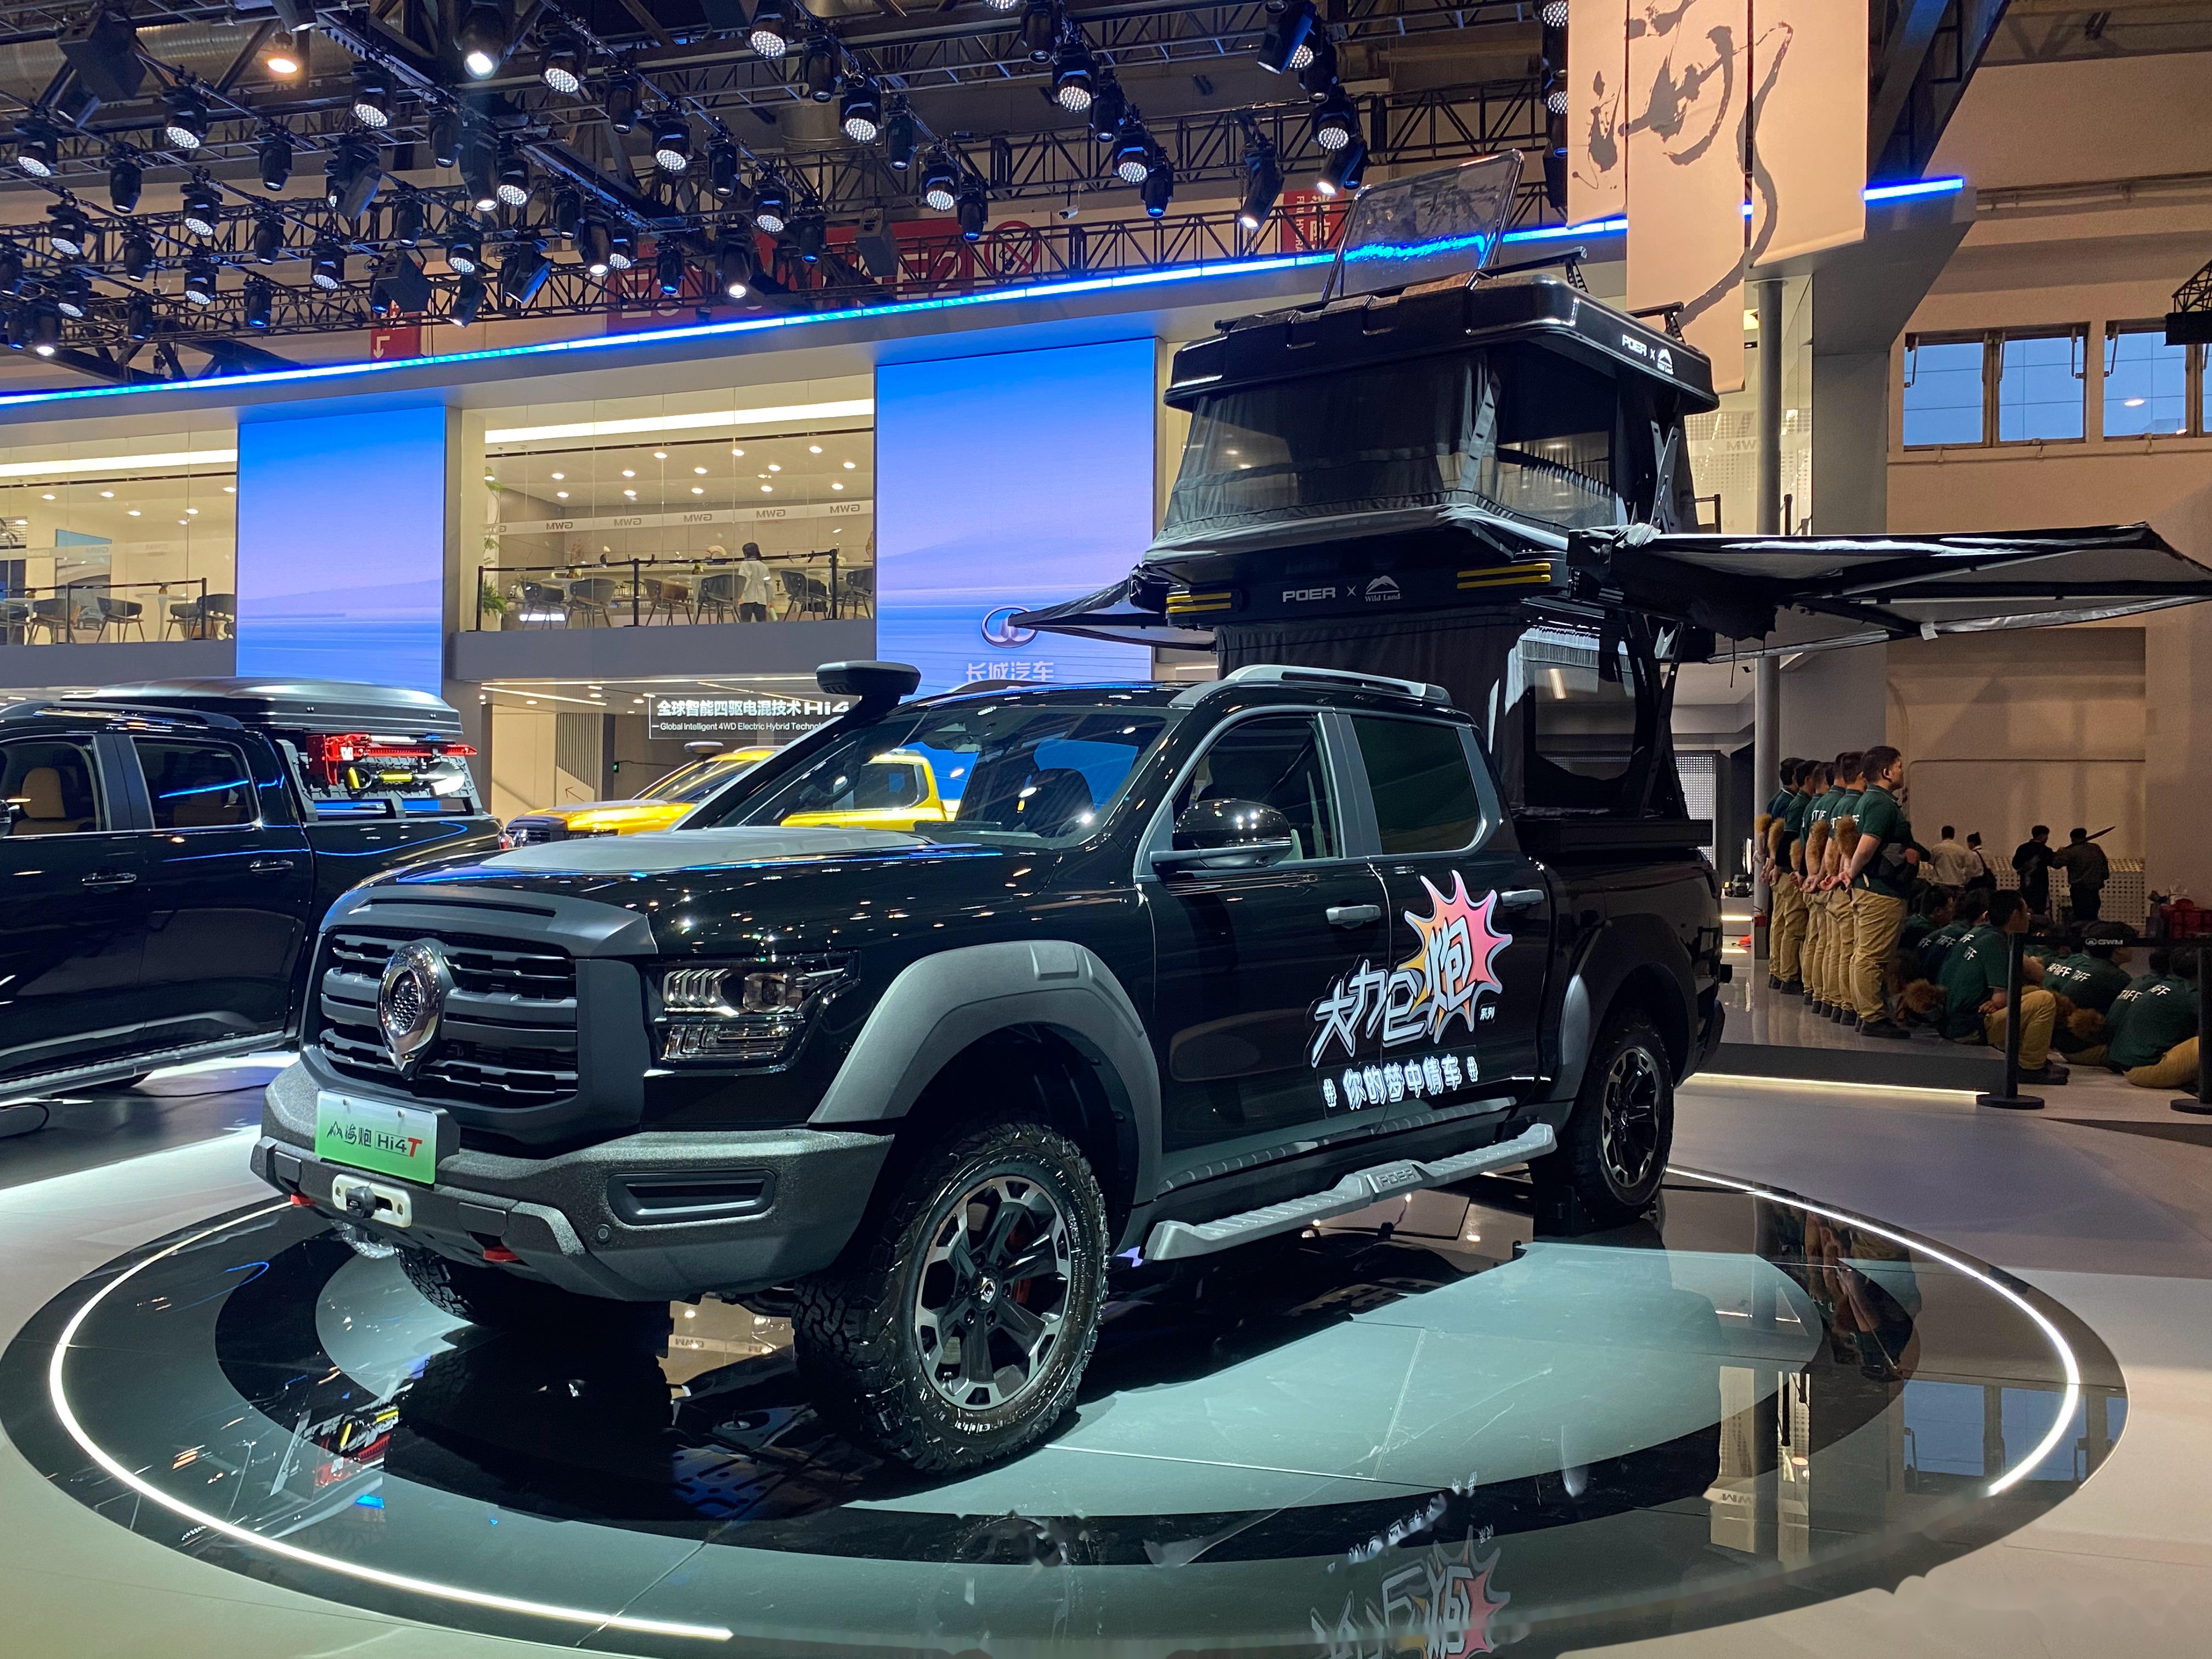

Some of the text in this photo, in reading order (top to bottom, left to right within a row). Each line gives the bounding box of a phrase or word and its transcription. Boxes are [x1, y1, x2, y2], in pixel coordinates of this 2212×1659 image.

[1622, 334, 1647, 356] POER
[1283, 587, 1336, 602] POER
[966, 661, 1054, 682] 长城汽车
[657, 700, 802, 716] 全球智能四驱电混技术
[684, 723, 718, 732] Intelligent
[766, 722, 790, 731] Hybrid
[377, 1133, 423, 1158] Hi4T
[1376, 1169, 1416, 1187] POER
